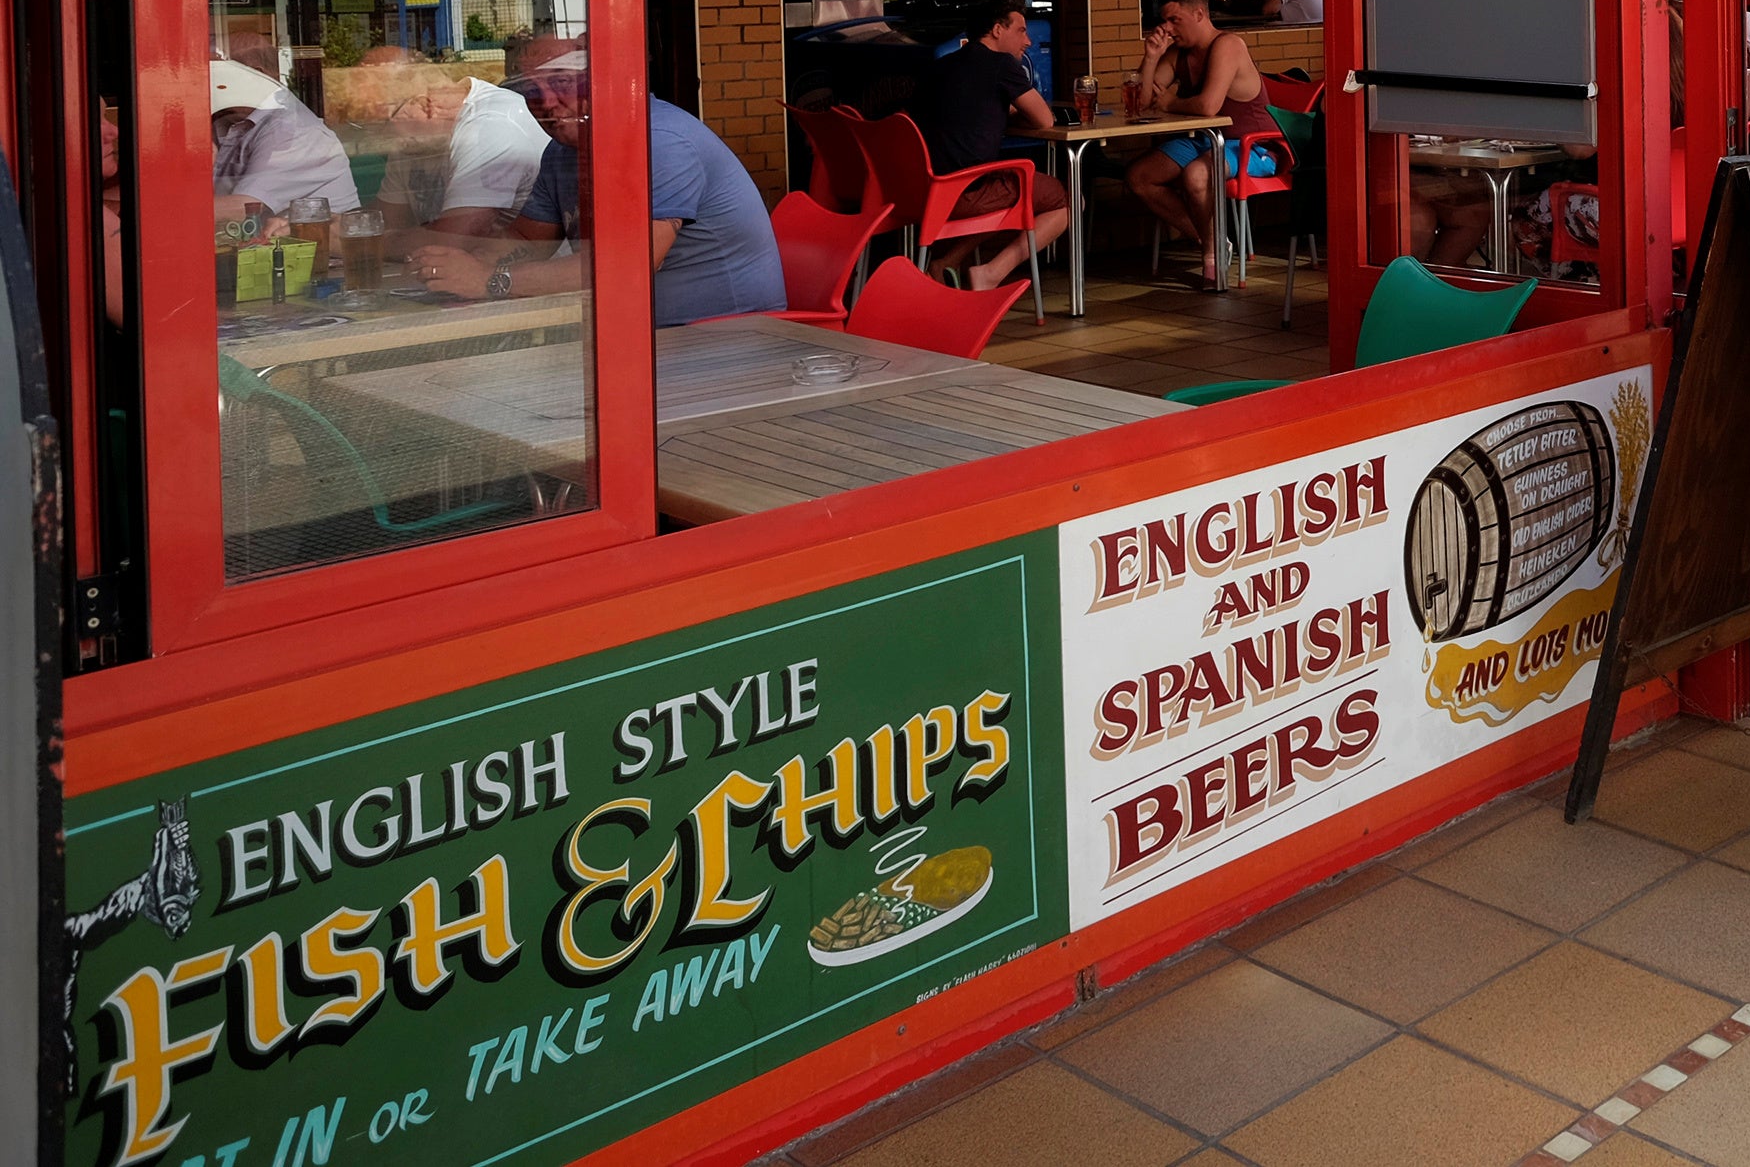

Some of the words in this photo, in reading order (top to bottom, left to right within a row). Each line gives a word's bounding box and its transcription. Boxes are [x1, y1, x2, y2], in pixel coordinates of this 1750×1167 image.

[1486, 415, 1526, 447] CHOOSE
[1497, 436, 1538, 470] TETLEY
[1540, 428, 1577, 450] BITTER
[1514, 461, 1569, 494] GUINNESS
[1520, 490, 1538, 510] ON
[1540, 471, 1588, 502] DRAUGHT
[1095, 455, 1389, 603] ENGLISH
[1513, 528, 1530, 549] OLD
[1531, 514, 1564, 541] ENGLISH
[1565, 498, 1592, 521] CIDER
[1519, 535, 1577, 579] HEINEKEN
[1207, 561, 1310, 628] AND
[1505, 565, 1570, 612] CRUZCAMPO
[1096, 590, 1392, 754] SPANISH
[1456, 651, 1508, 702] AND
[1518, 624, 1569, 677] LOTS
[1575, 609, 1611, 654] MO
[222, 731, 571, 907] ENGLISH
[617, 658, 821, 778] STYLE
[1106, 690, 1381, 877] BEERS
[99, 853, 525, 1167] FISH
[558, 796, 678, 972] &
[683, 689, 1012, 929] CHIPS
[273, 1097, 346, 1167] IN
[368, 1088, 436, 1144] OR
[466, 994, 611, 1102] TAKE
[632, 923, 782, 1032] AWAY
